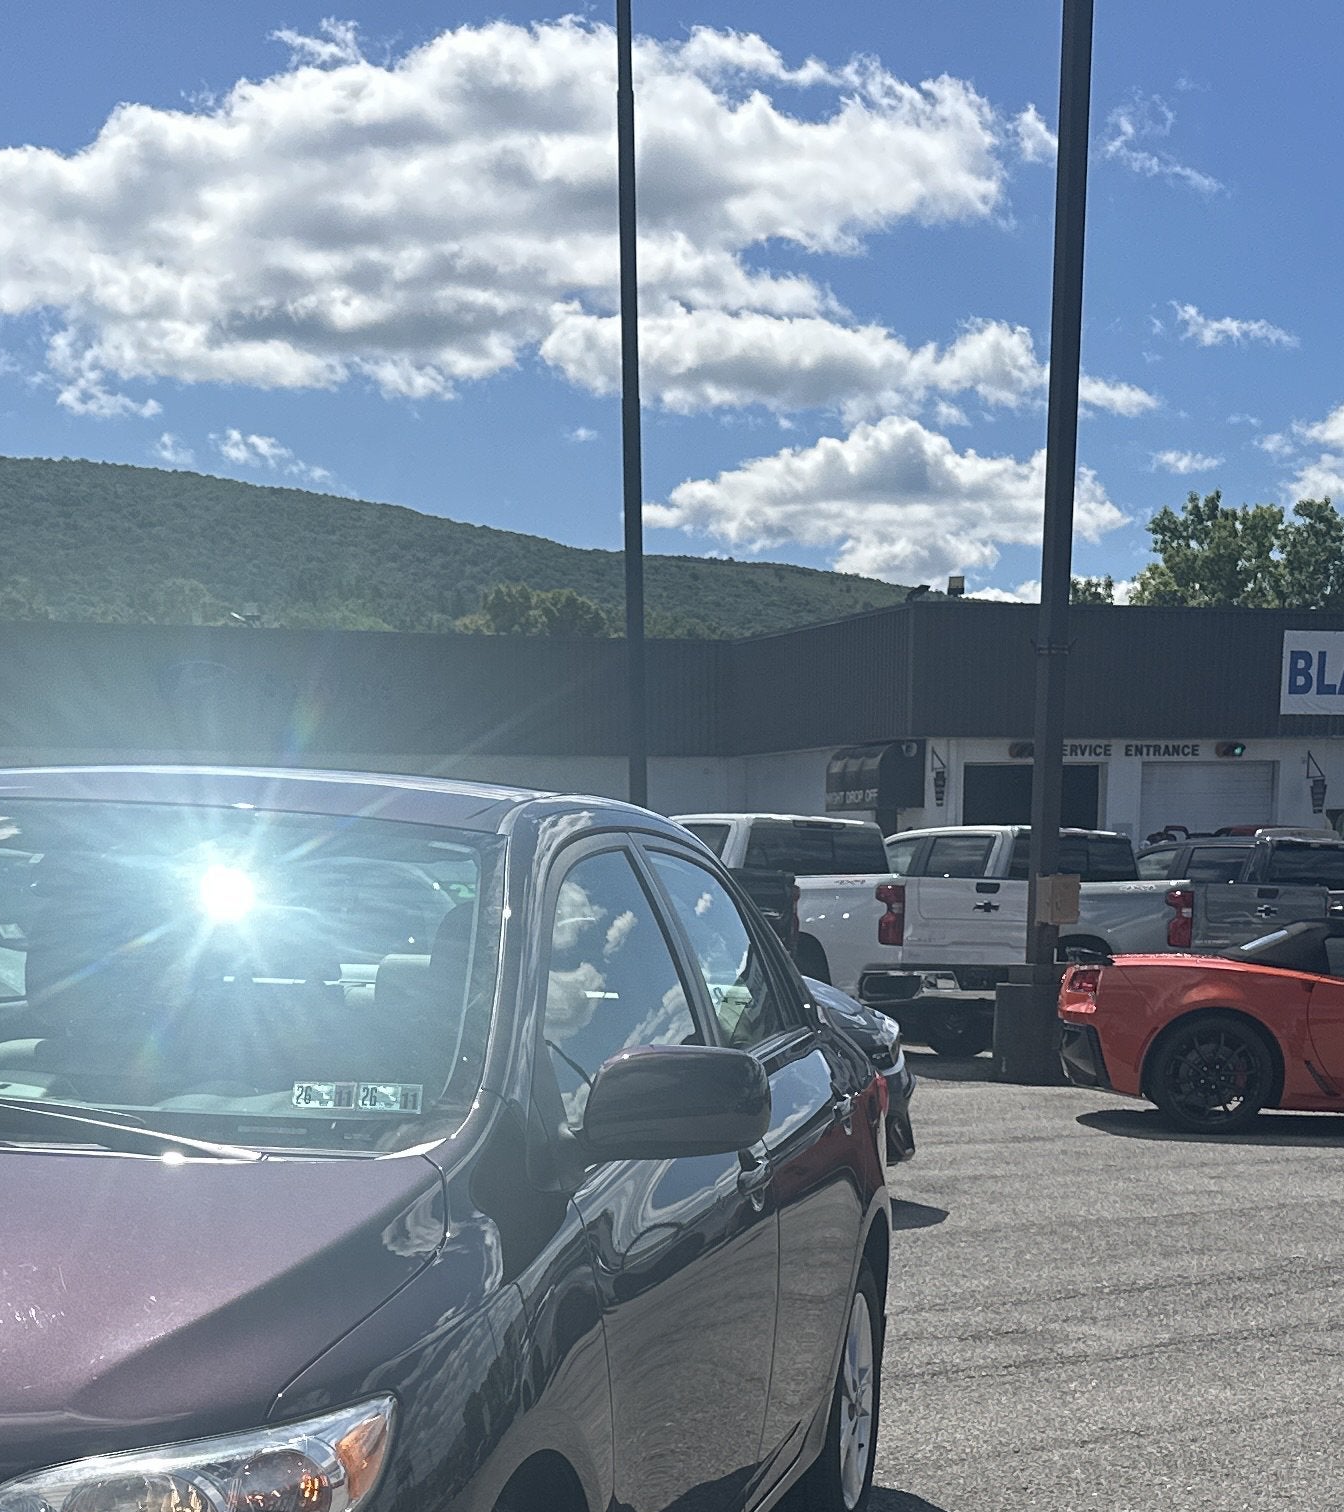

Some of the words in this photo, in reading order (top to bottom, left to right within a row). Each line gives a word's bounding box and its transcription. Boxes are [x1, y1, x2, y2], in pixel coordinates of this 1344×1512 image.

[1062, 744, 1112, 757] ERVICE
[1125, 744, 1200, 757] ENTRANCE
[846, 790, 864, 804] DROP
[865, 788, 879, 802] OFF
[296, 1085, 312, 1104] 26
[337, 1089, 353, 1107] 11
[362, 1086, 377, 1106] 26
[402, 1092, 418, 1110] 11
